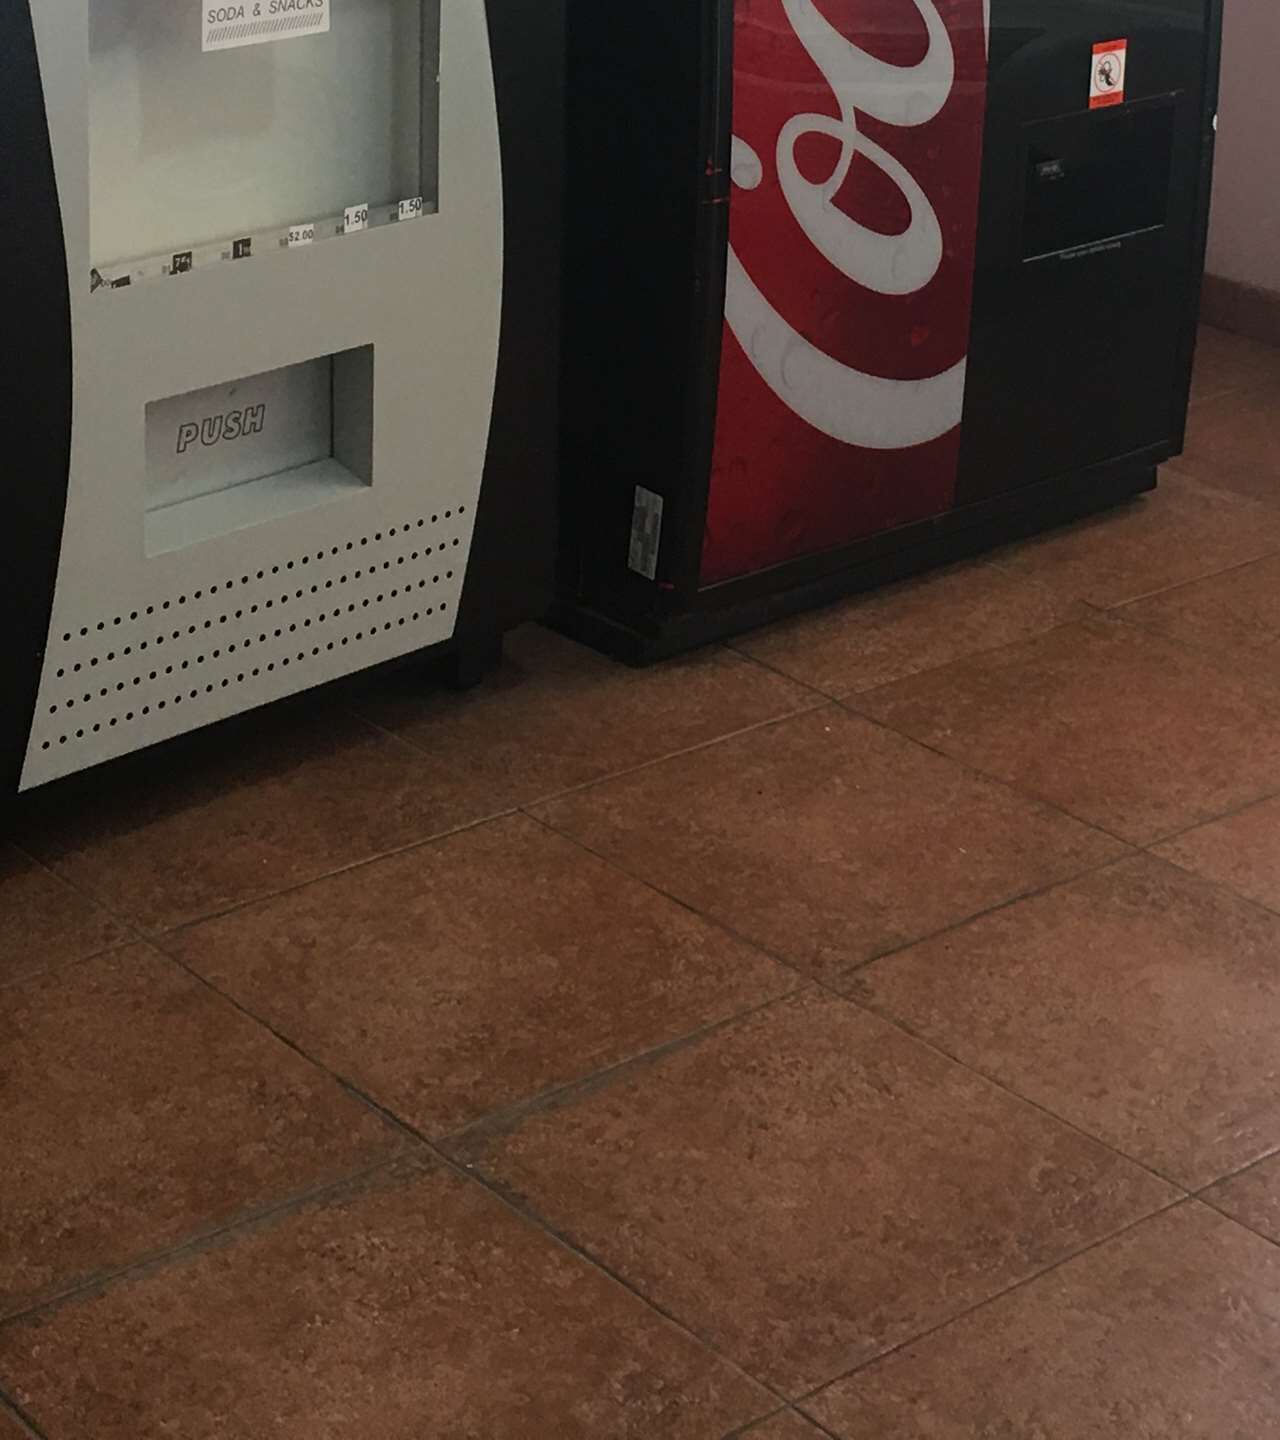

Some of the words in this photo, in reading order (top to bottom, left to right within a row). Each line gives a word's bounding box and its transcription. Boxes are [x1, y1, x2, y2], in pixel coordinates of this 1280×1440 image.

[207, 6, 245, 24] SODA
[252, 3, 261, 17] &
[400, 199, 421, 215] 1.50
[344, 210, 368, 225] 1.50
[289, 229, 314, 242] $2.00
[176, 403, 265, 453] PUSH
